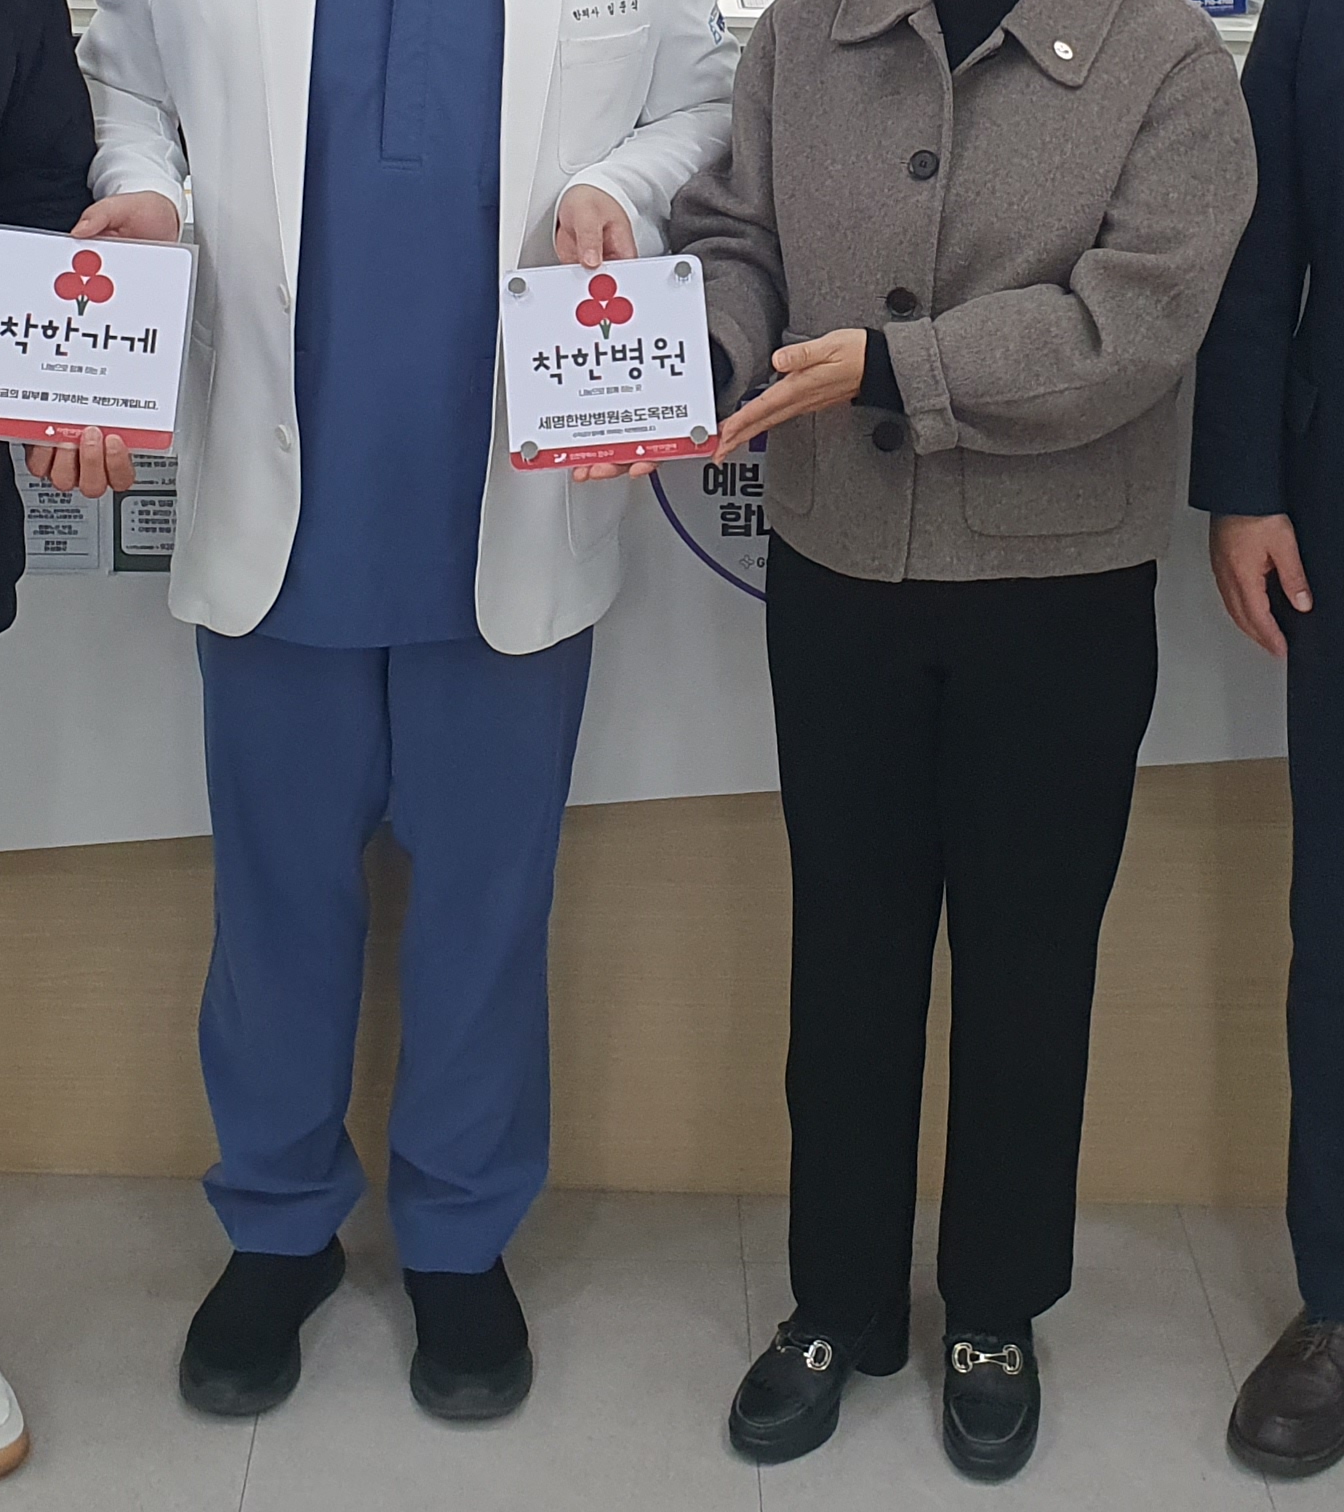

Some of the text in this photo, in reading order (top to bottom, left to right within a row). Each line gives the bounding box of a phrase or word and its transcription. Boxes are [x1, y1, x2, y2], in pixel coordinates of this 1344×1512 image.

[0, 313, 157, 356] 착한가게
[532, 338, 686, 384] 착한병원
[51, 392, 89, 405] 기부하는
[538, 405, 688, 430] 세명한방병원송도옥련점
